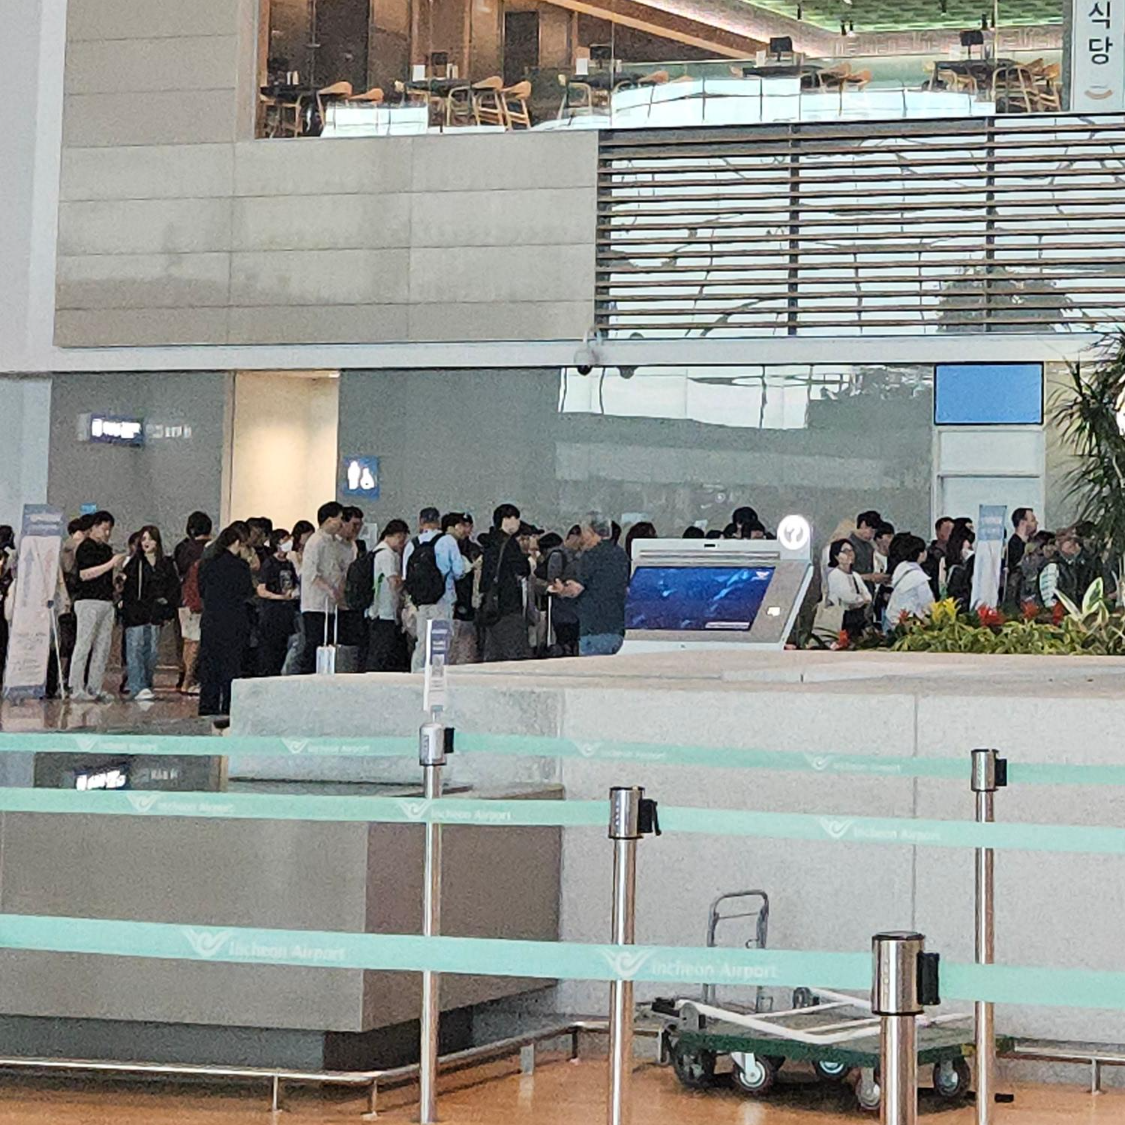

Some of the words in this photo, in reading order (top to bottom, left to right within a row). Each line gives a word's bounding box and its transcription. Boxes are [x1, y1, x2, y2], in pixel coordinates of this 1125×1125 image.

[229, 941, 287, 957] Incheon
[290, 943, 346, 962] Airport
[652, 961, 716, 978] Incheon
[722, 962, 778, 982] Airport
